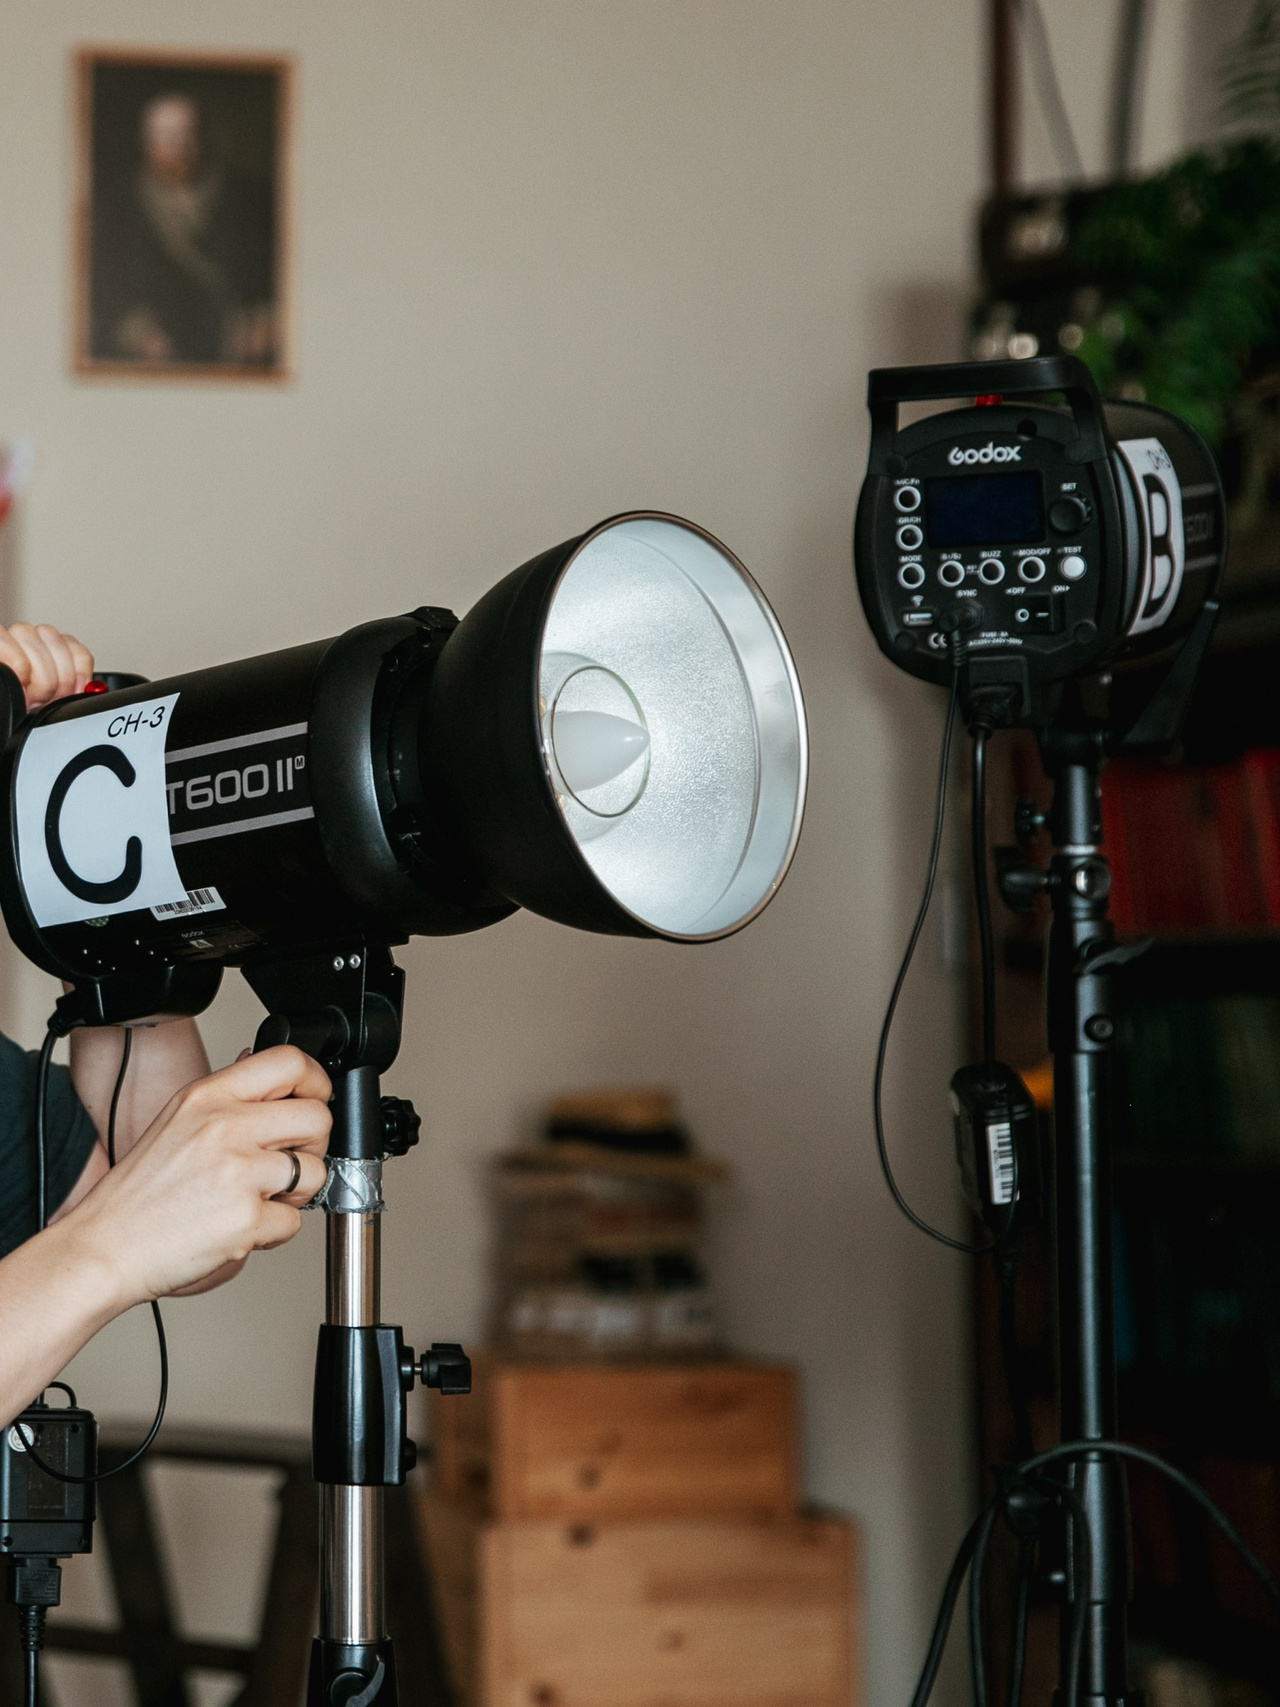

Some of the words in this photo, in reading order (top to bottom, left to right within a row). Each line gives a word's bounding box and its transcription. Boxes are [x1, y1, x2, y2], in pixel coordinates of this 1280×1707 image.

[948, 441, 1022, 466] Godox
[1061, 482, 1077, 491] SET
[1143, 473, 1175, 620] B
[980, 550, 1002, 560] BUZZ
[1018, 547, 1052, 556] MOD/OFF
[900, 554, 923, 563] MODE
[956, 589, 978, 598] SYNC
[1011, 587, 1026, 595] OFF
[1052, 585, 1066, 594] ON
[107, 705, 166, 738] CH-3
[44, 744, 142, 904] C
